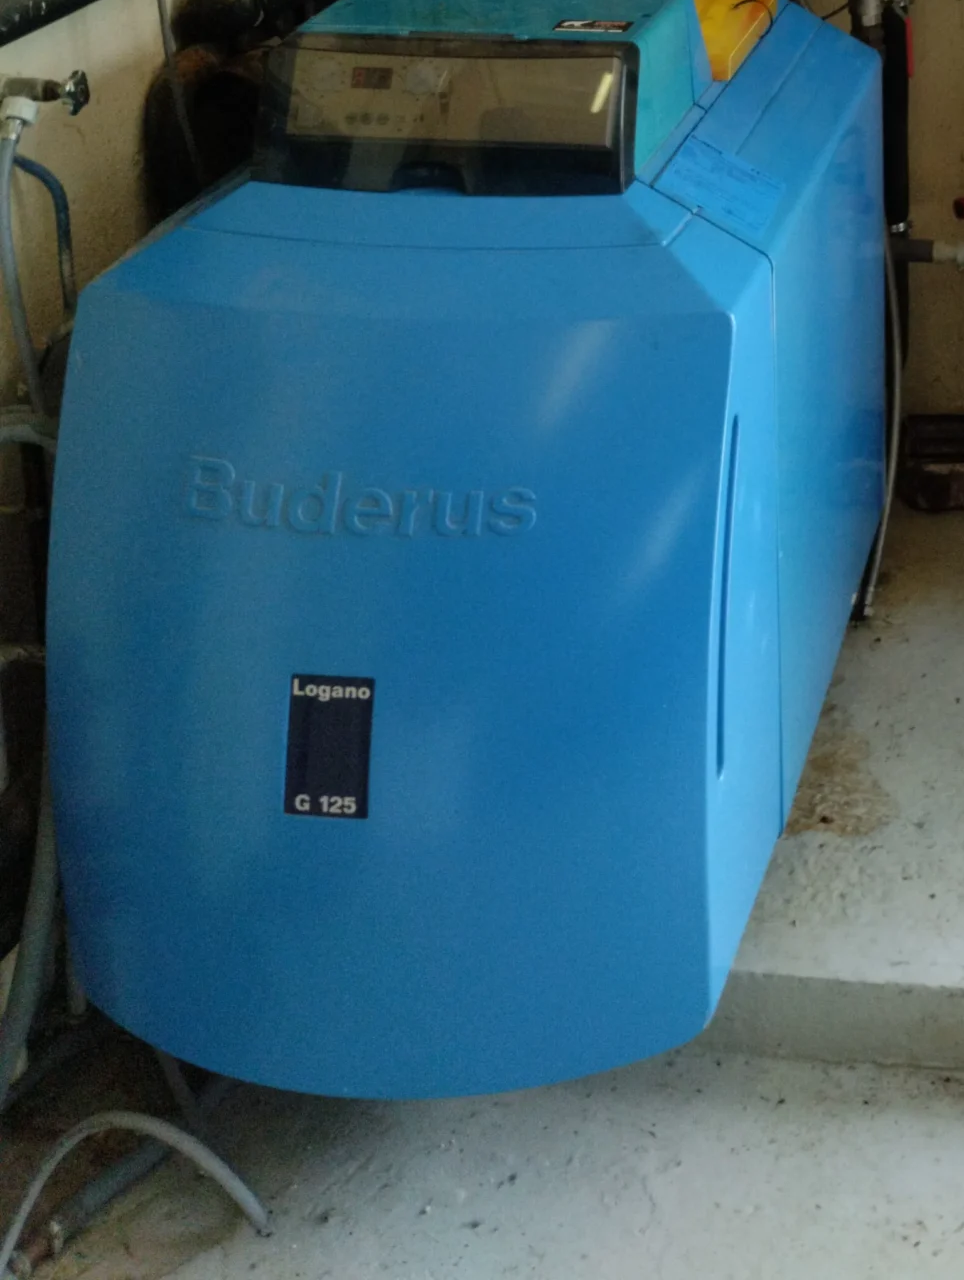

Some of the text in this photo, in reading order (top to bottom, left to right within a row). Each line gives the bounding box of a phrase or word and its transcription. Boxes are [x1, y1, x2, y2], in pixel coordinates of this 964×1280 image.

[185, 453, 540, 538] Buderus
[292, 677, 371, 702] Logano
[294, 793, 357, 815] G 125
